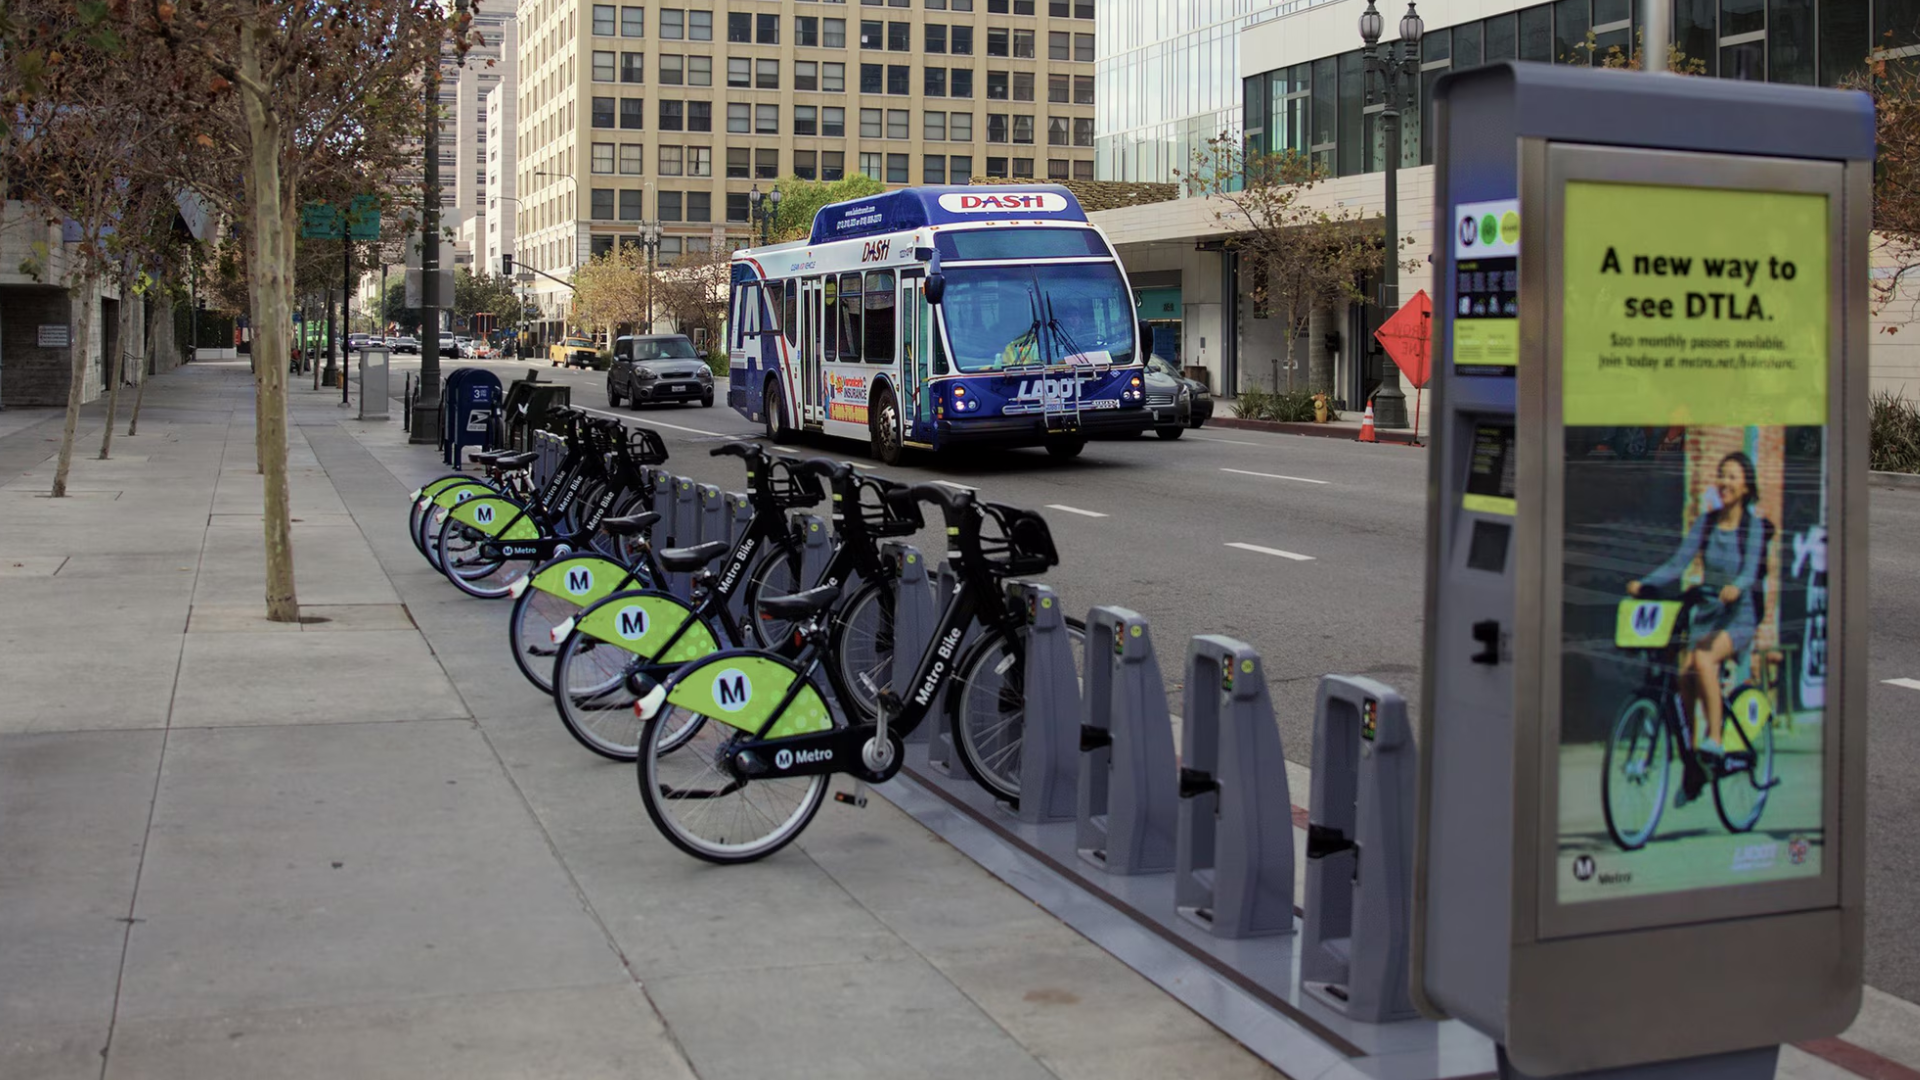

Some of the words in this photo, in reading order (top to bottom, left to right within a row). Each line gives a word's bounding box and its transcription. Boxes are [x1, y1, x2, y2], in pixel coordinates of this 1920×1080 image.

[961, 195, 1044, 209] DASH
[862, 239, 890, 262] DASH
[1601, 247, 1621, 274] A
[1633, 255, 1692, 276] new
[1703, 258, 1758, 287] way
[1769, 256, 1797, 280] to
[1625, 297, 1674, 318] see
[1686, 291, 1774, 321] DTLA.
[1638, 334, 1686, 352] monthly
[1690, 336, 1730, 351] passes
[1599, 354, 1621, 370] Join
[1626, 354, 1658, 371] today
[1663, 355, 1675, 368] at
[474, 389, 480, 398] 3
[1017, 379, 1085, 399] LADOT
[542, 485, 558, 506] Metro
[554, 470, 566, 485] Bike
[558, 491, 573, 513] Metro
[570, 475, 583, 491] Bike
[478, 507, 491, 521] M
[586, 508, 604, 531] Metro
[600, 491, 615, 508] Bike
[718, 562, 741, 594] Metro
[736, 538, 755, 561] Bike
[570, 571, 589, 590] M
[622, 611, 644, 634] M
[915, 661, 945, 706] Metro
[938, 627, 962, 659] Bike
[719, 675, 746, 705] M
[796, 749, 833, 764] Metro
